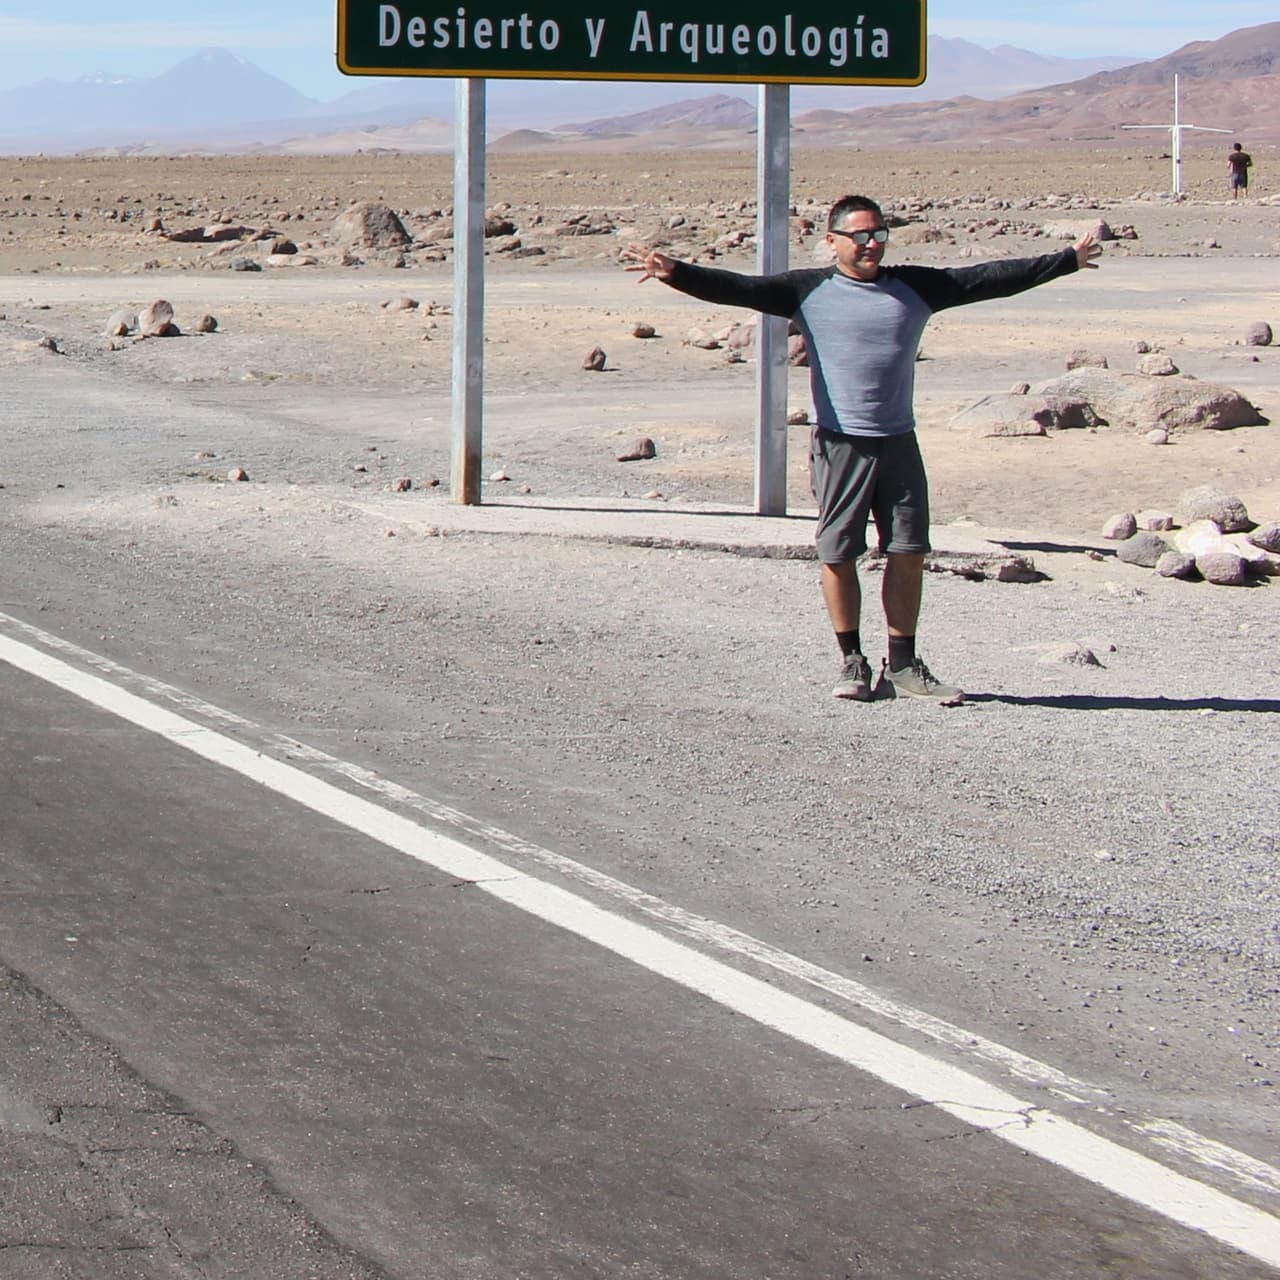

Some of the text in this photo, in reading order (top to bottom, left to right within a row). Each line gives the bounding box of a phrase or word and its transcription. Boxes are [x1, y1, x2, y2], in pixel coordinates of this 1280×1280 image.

[378, 4, 889, 67] Desierto y Arqueología
